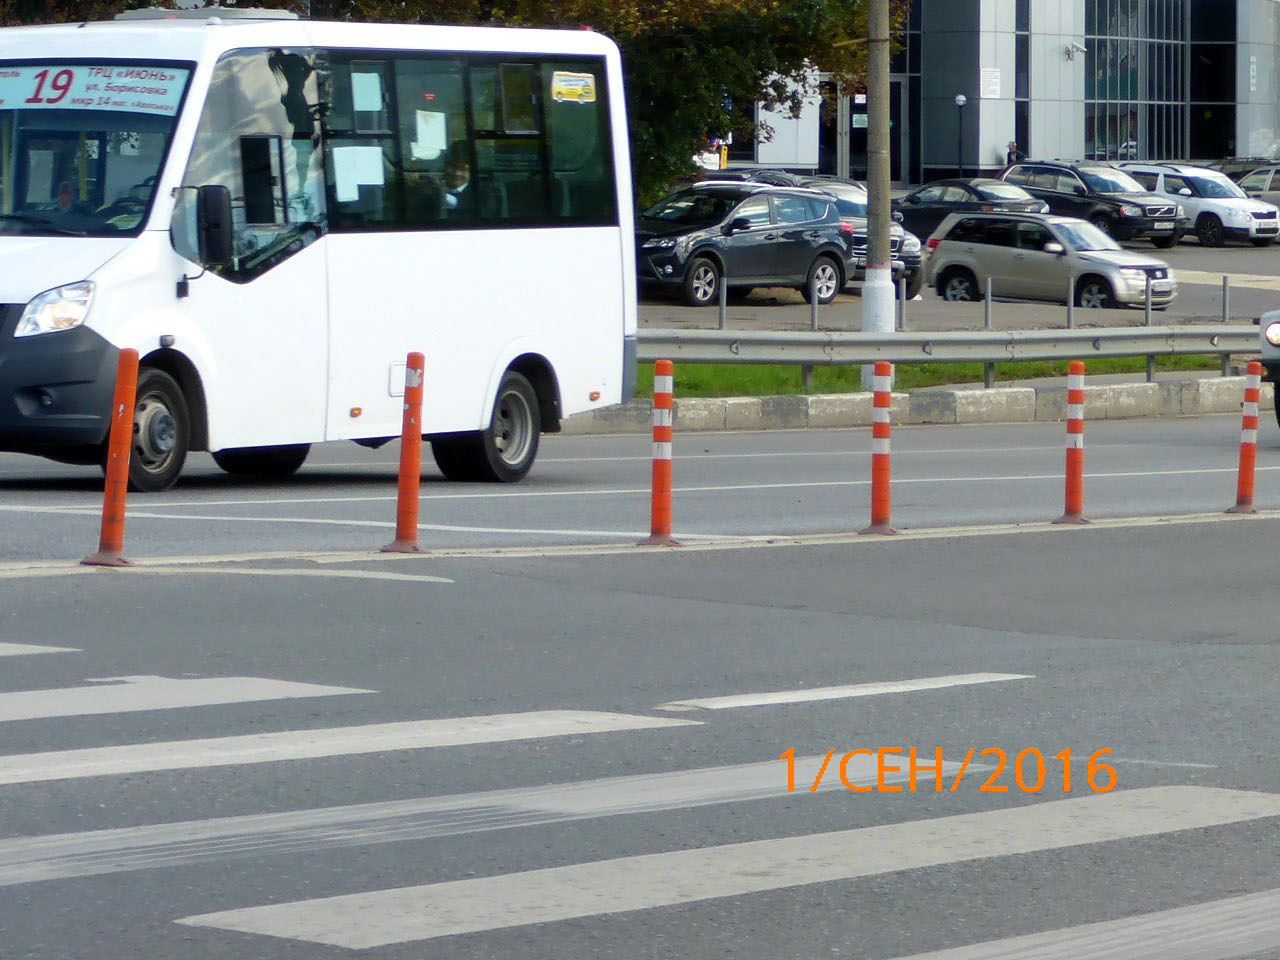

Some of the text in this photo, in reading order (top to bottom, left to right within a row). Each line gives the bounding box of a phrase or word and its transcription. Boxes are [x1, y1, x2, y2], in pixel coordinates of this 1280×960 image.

[87, 67, 176, 82] ТРЦ «ИЮНЬ»
[25, 68, 75, 105] 19
[104, 82, 169, 96] Борисовка
